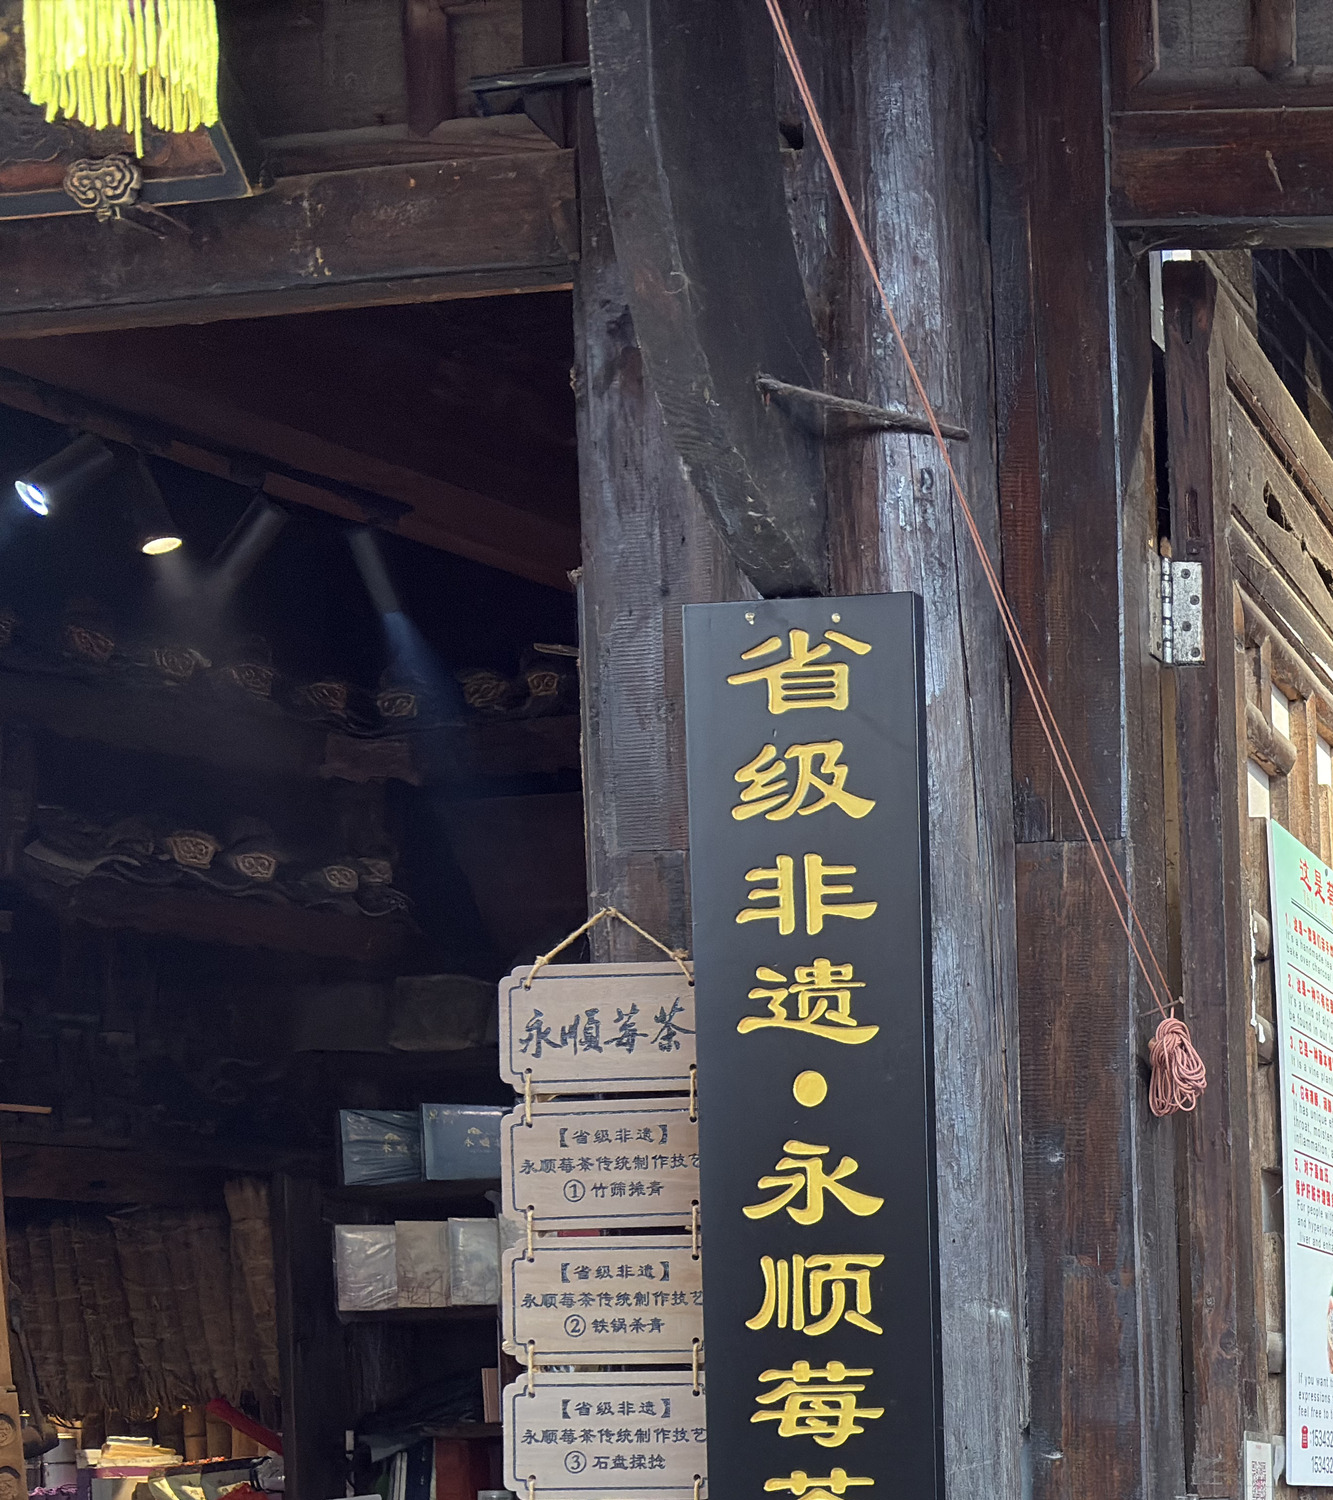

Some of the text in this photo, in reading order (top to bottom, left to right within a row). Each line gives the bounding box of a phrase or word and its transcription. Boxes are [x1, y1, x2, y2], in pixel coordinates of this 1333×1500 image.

[1304, 1372, 1314, 1388] you
[1315, 1374, 1328, 1388] want
[1298, 1404, 1309, 1418] feel
[1310, 1406, 1321, 1419] free
